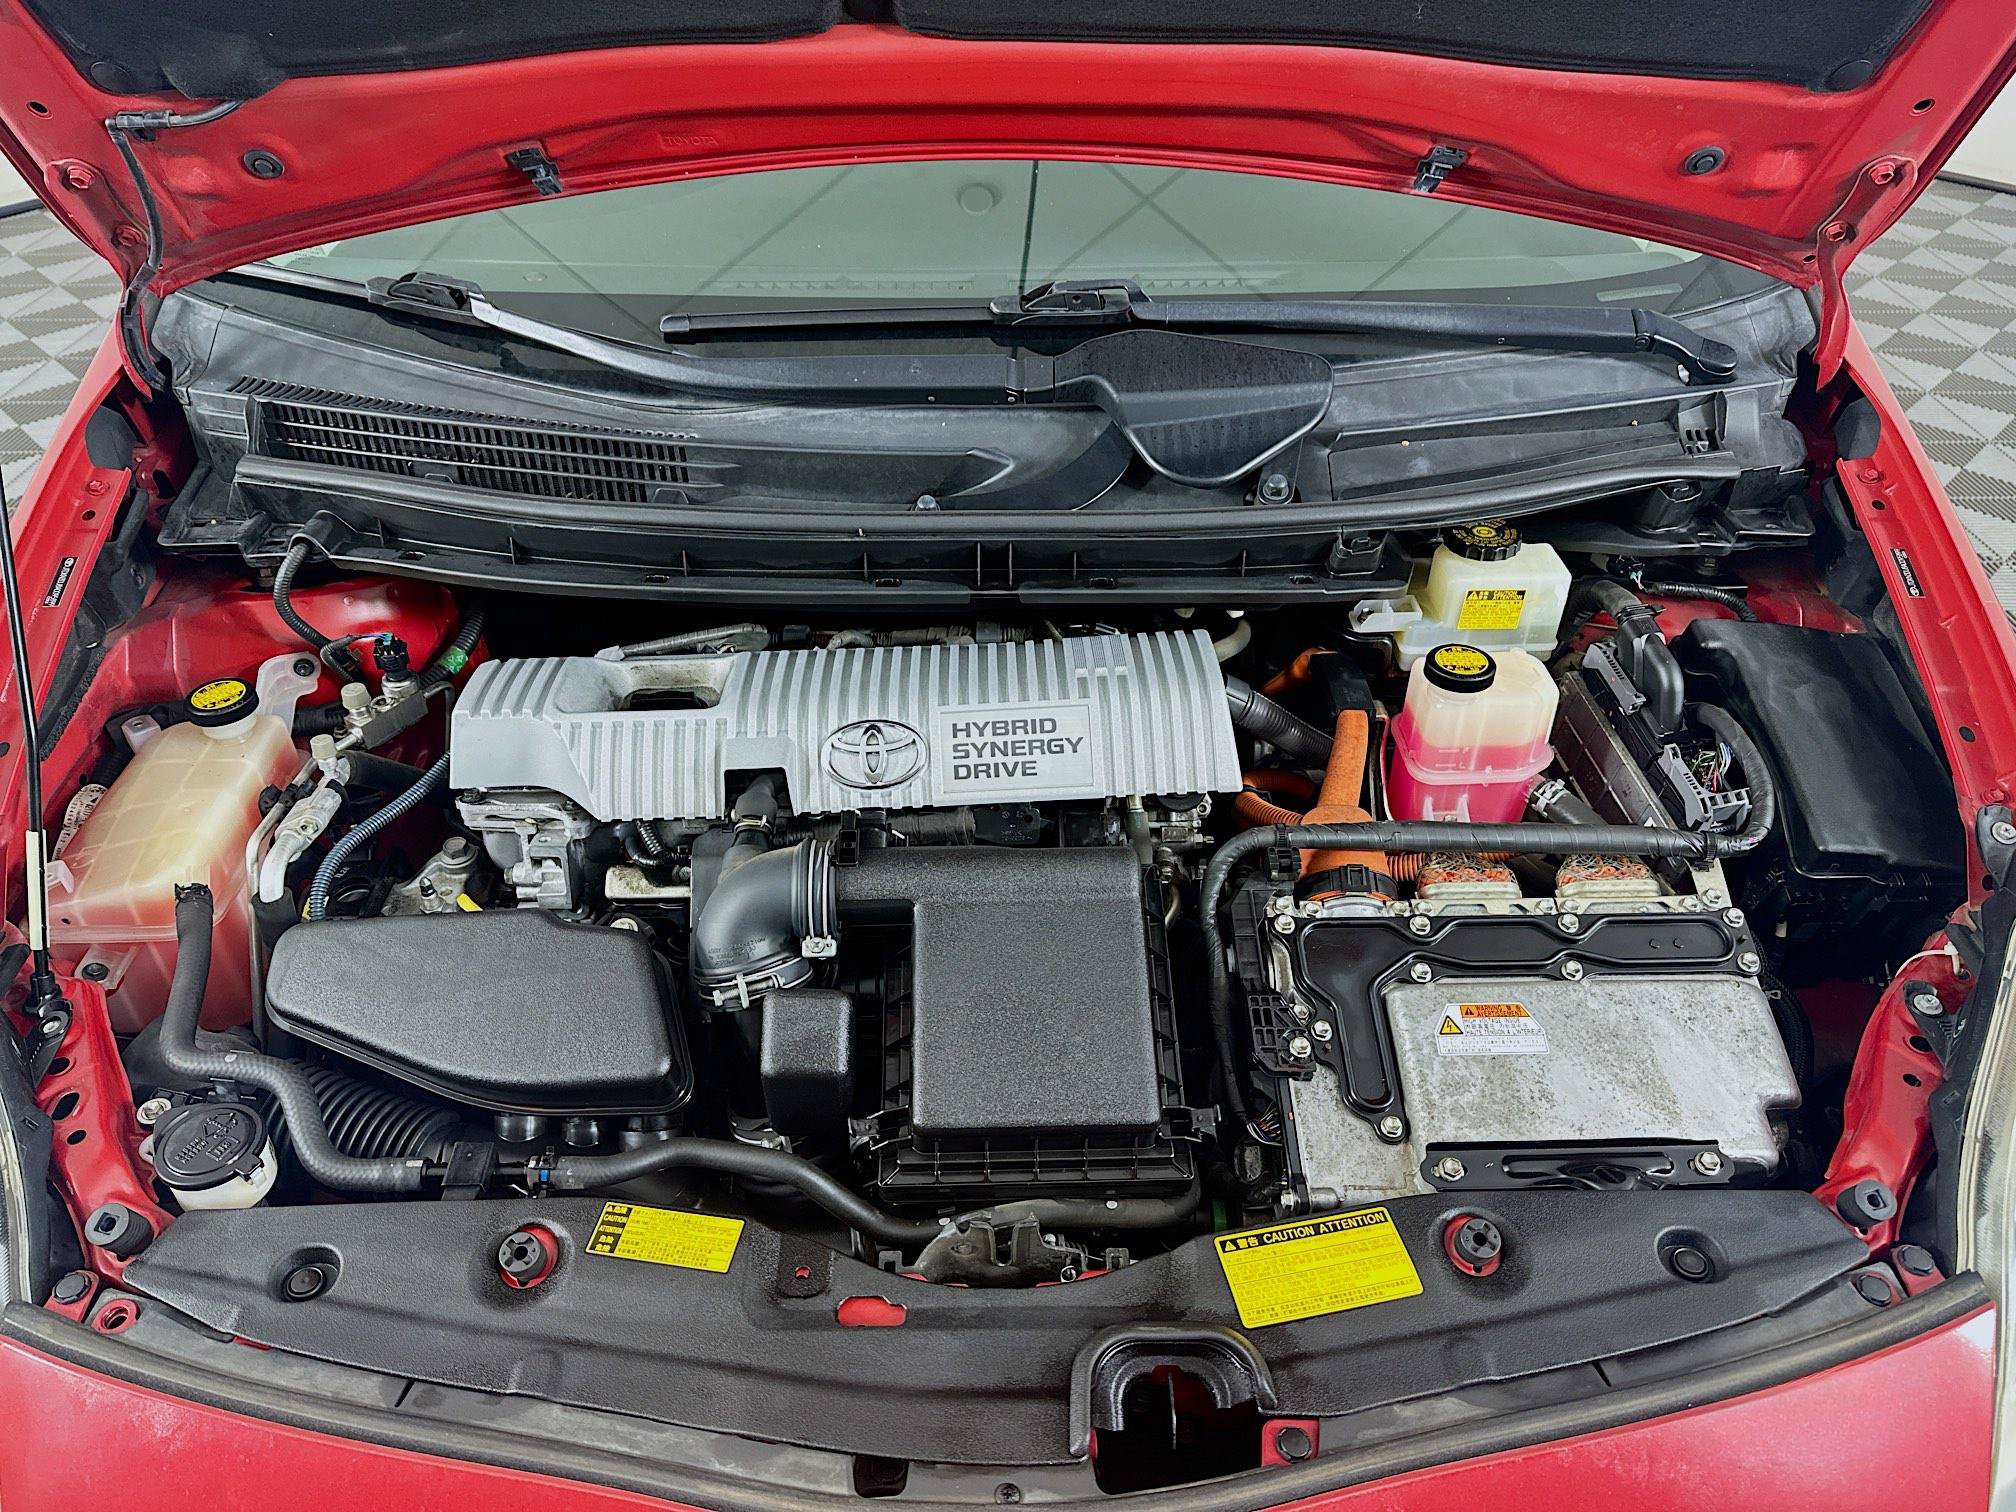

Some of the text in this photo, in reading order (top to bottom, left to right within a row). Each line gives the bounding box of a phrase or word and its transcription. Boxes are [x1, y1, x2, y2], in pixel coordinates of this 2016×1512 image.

[665, 135, 719, 145] TOYOTA
[952, 718, 1057, 738] HYBRID
[952, 737, 1084, 759] SYNERGY
[953, 760, 1038, 780] DRIVE
[603, 1214, 628, 1223] CAUTION
[1263, 1225, 1315, 1244] CAUTION
[1319, 1212, 1386, 1233] ATTENTION
